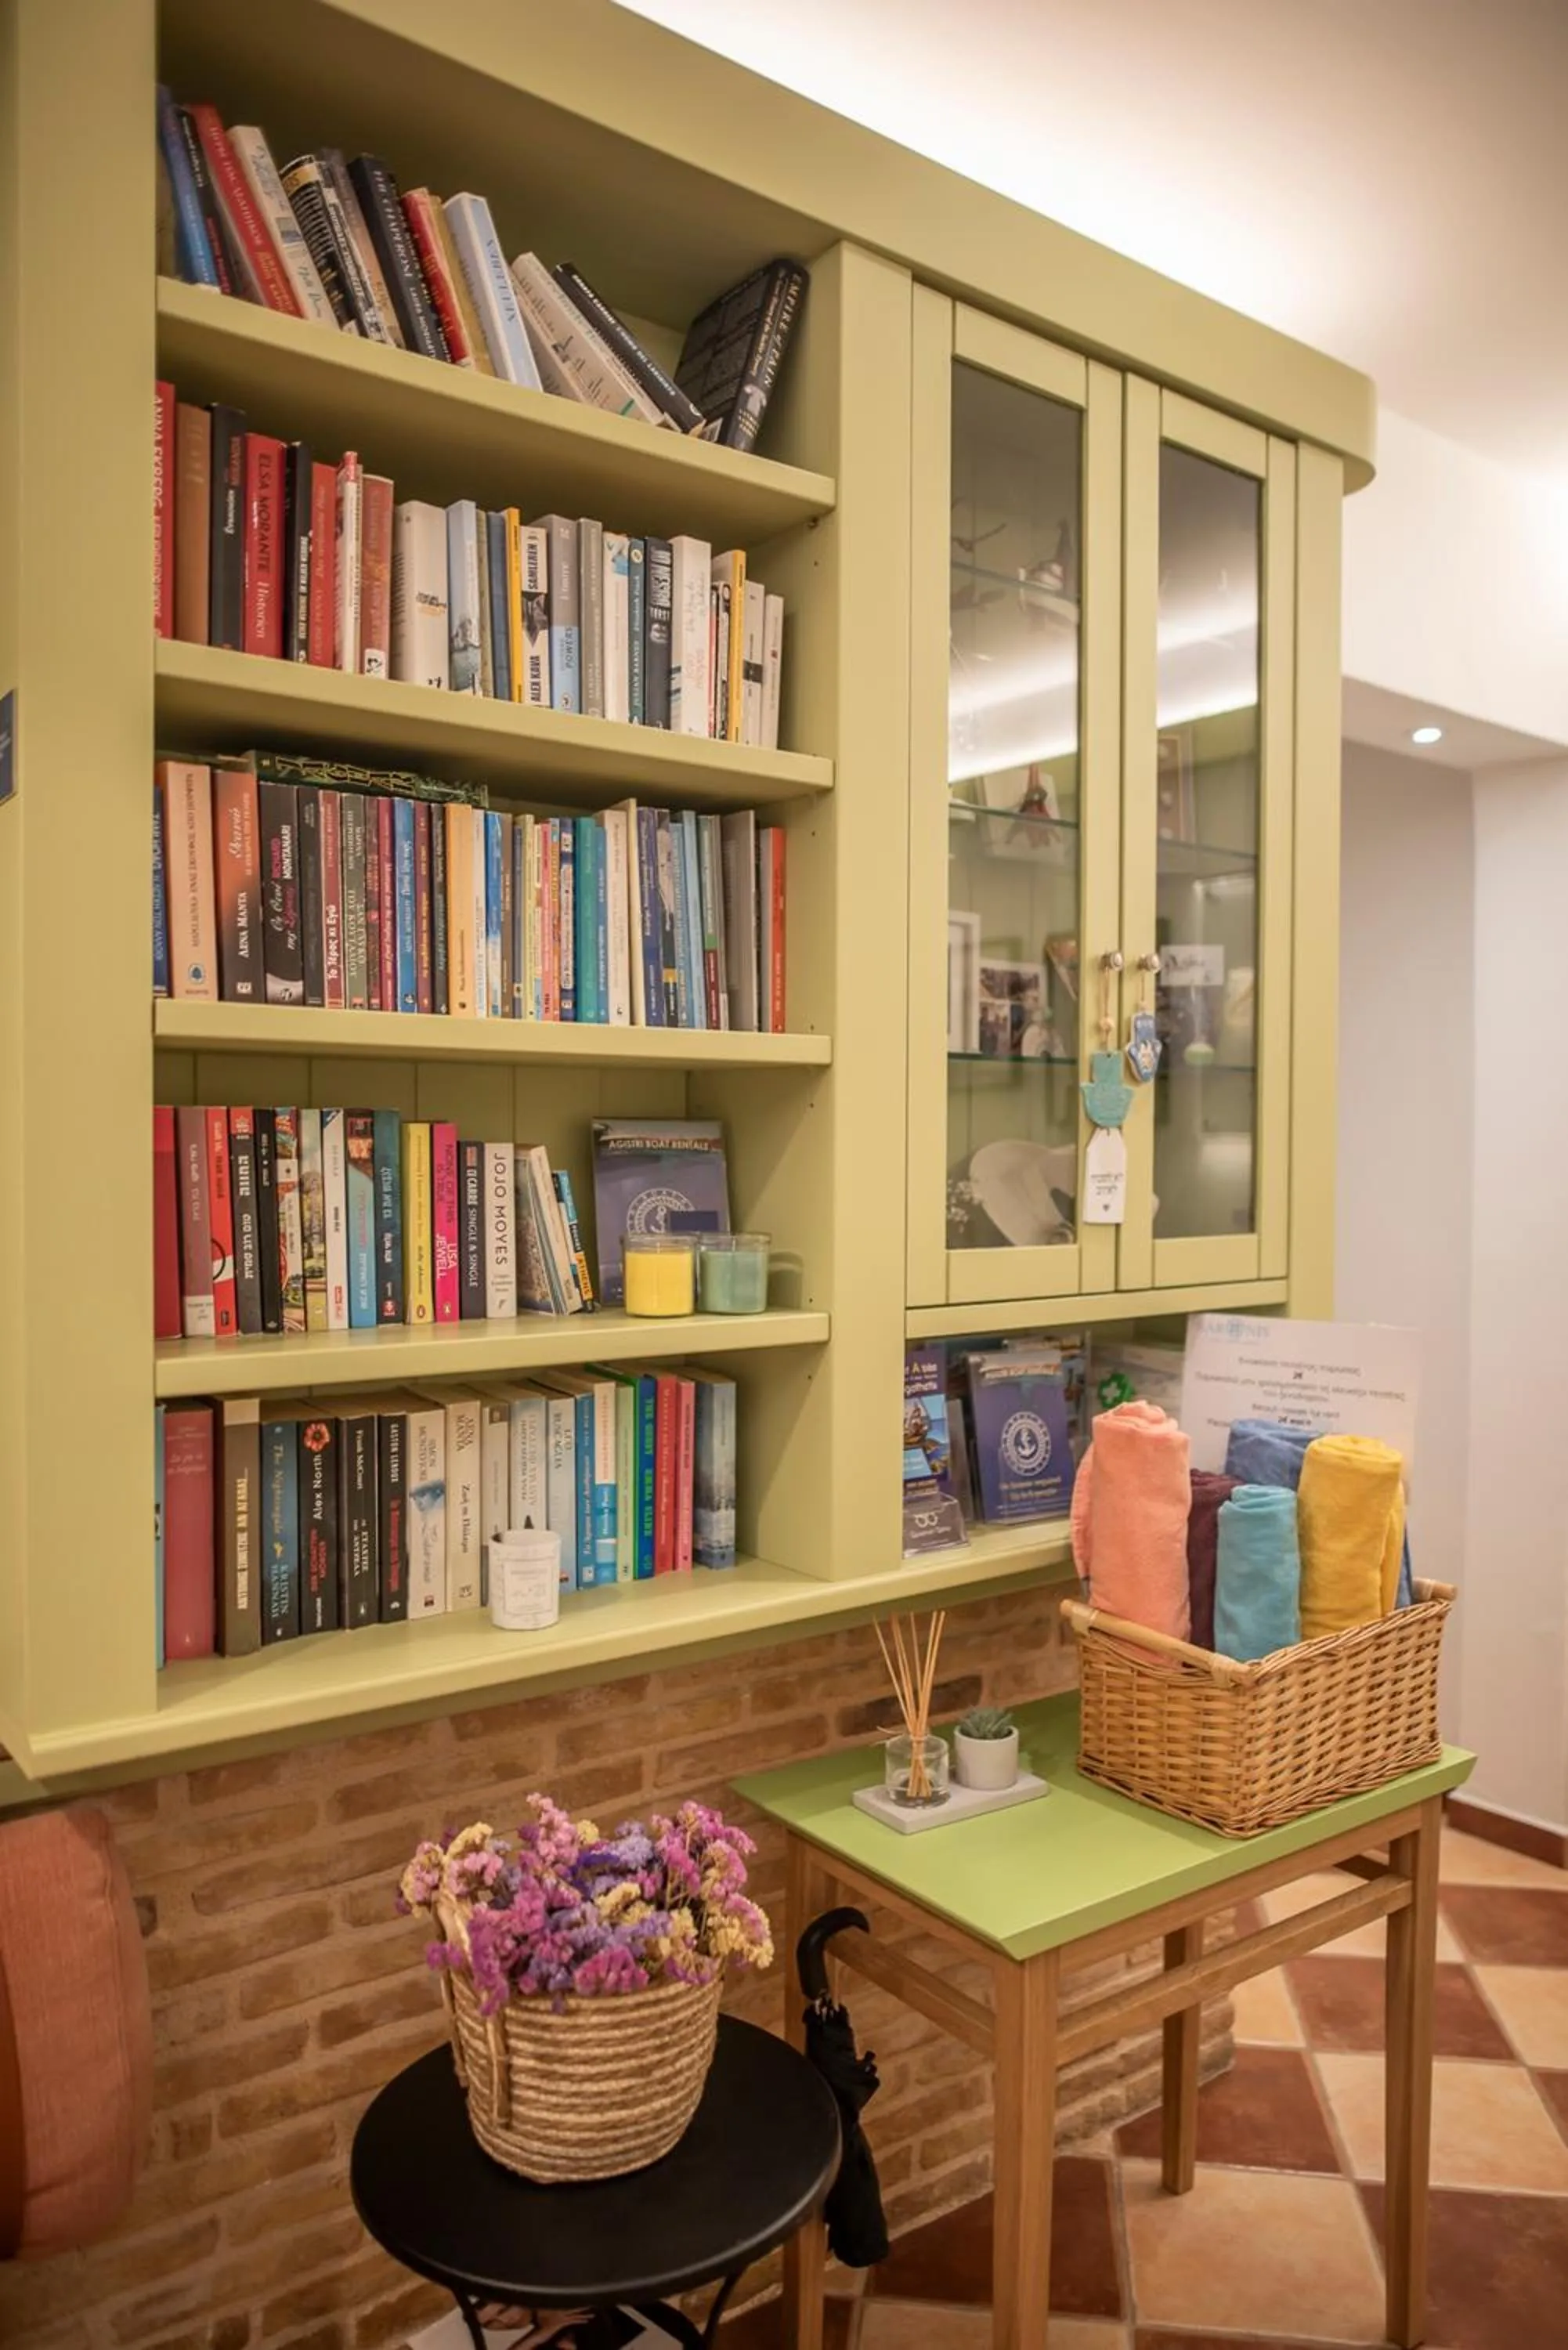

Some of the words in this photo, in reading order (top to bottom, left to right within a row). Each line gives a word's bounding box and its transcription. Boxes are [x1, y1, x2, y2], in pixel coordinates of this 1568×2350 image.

[775, 272, 804, 331] EMPIRE
[258, 453, 273, 491] ELSA
[258, 495, 273, 575] MORANTE
[255, 580, 273, 638] Historien
[280, 825, 293, 880] MONTANARI
[609, 1140, 643, 1150] AGISTRI
[645, 1140, 671, 1150] BOAT
[672, 1140, 710, 1151] RENTALS
[494, 1152, 508, 1198] JOJO
[468, 1206, 477, 1241] SINGLE
[494, 1205, 509, 1266] MOYES
[435, 1232, 448, 1278] JEWELL
[447, 1242, 458, 1268] LISA
[468, 1253, 479, 1289] SINGLE
[273, 1444, 284, 1465] The
[356, 1429, 365, 1453] Frank
[553, 1412, 564, 1470] BUSCAGLIA
[563, 1428, 573, 1451] LEO
[311, 1454, 323, 1489] North
[356, 1454, 366, 1490] McCourt
[271, 1468, 285, 1535] Nightingale
[311, 1492, 323, 1520] Alex
[270, 1564, 280, 1618] HANNAH
[280, 1564, 290, 1614] KRISTIN
